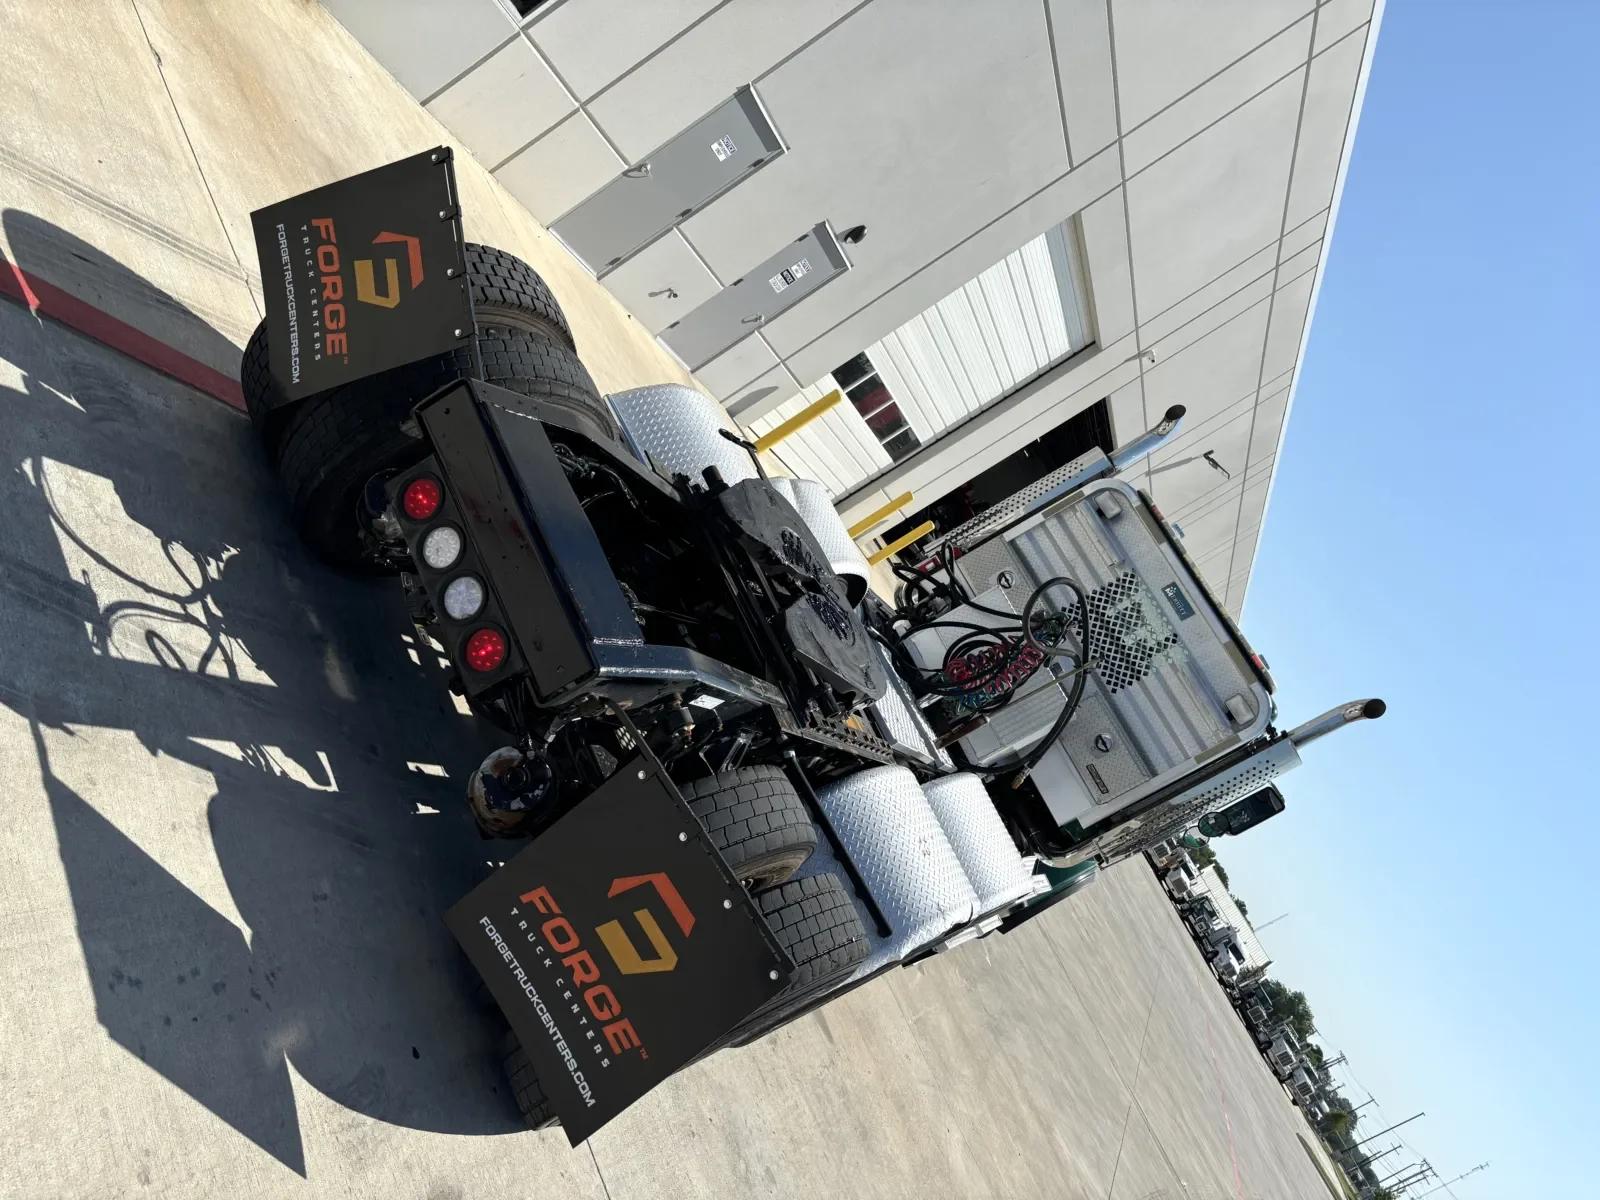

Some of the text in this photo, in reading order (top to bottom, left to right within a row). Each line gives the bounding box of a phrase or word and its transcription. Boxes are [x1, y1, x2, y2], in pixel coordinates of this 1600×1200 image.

[276, 223, 300, 384] FORGETRUCKCENTERS.COM
[300, 224, 321, 361] TRUCK CENTERS
[312, 218, 348, 356] FORGE
[479, 915, 596, 1108] FORGETRUCKCENTERS.COM
[510, 907, 611, 1068] TRUCK CENTERS
[519, 885, 642, 1056] FORGE
